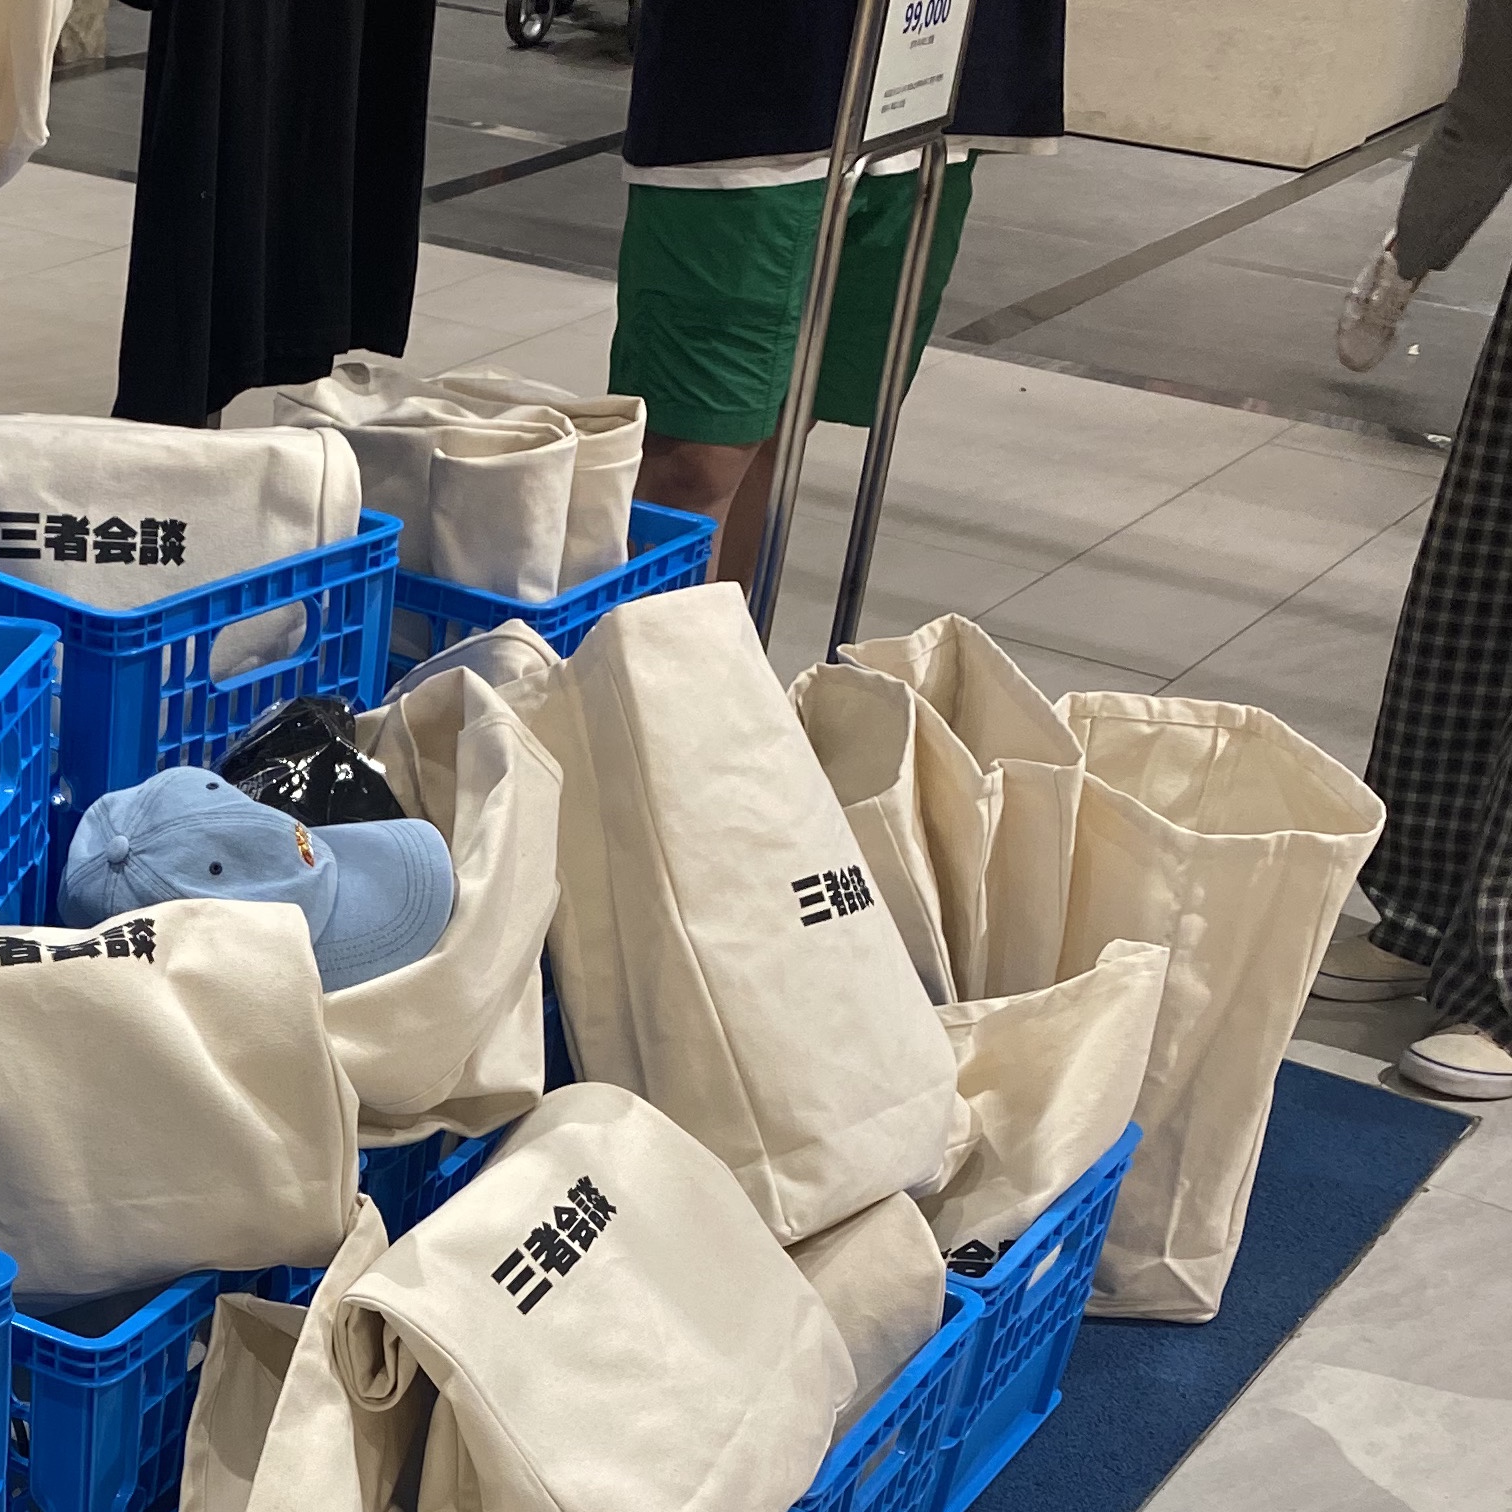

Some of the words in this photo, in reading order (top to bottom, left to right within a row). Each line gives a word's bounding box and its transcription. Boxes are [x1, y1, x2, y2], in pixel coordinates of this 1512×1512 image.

[902, 0, 951, 35] 99,000
[792, 866, 874, 926] 三者会談
[491, 1175, 616, 1315] 三者会談
